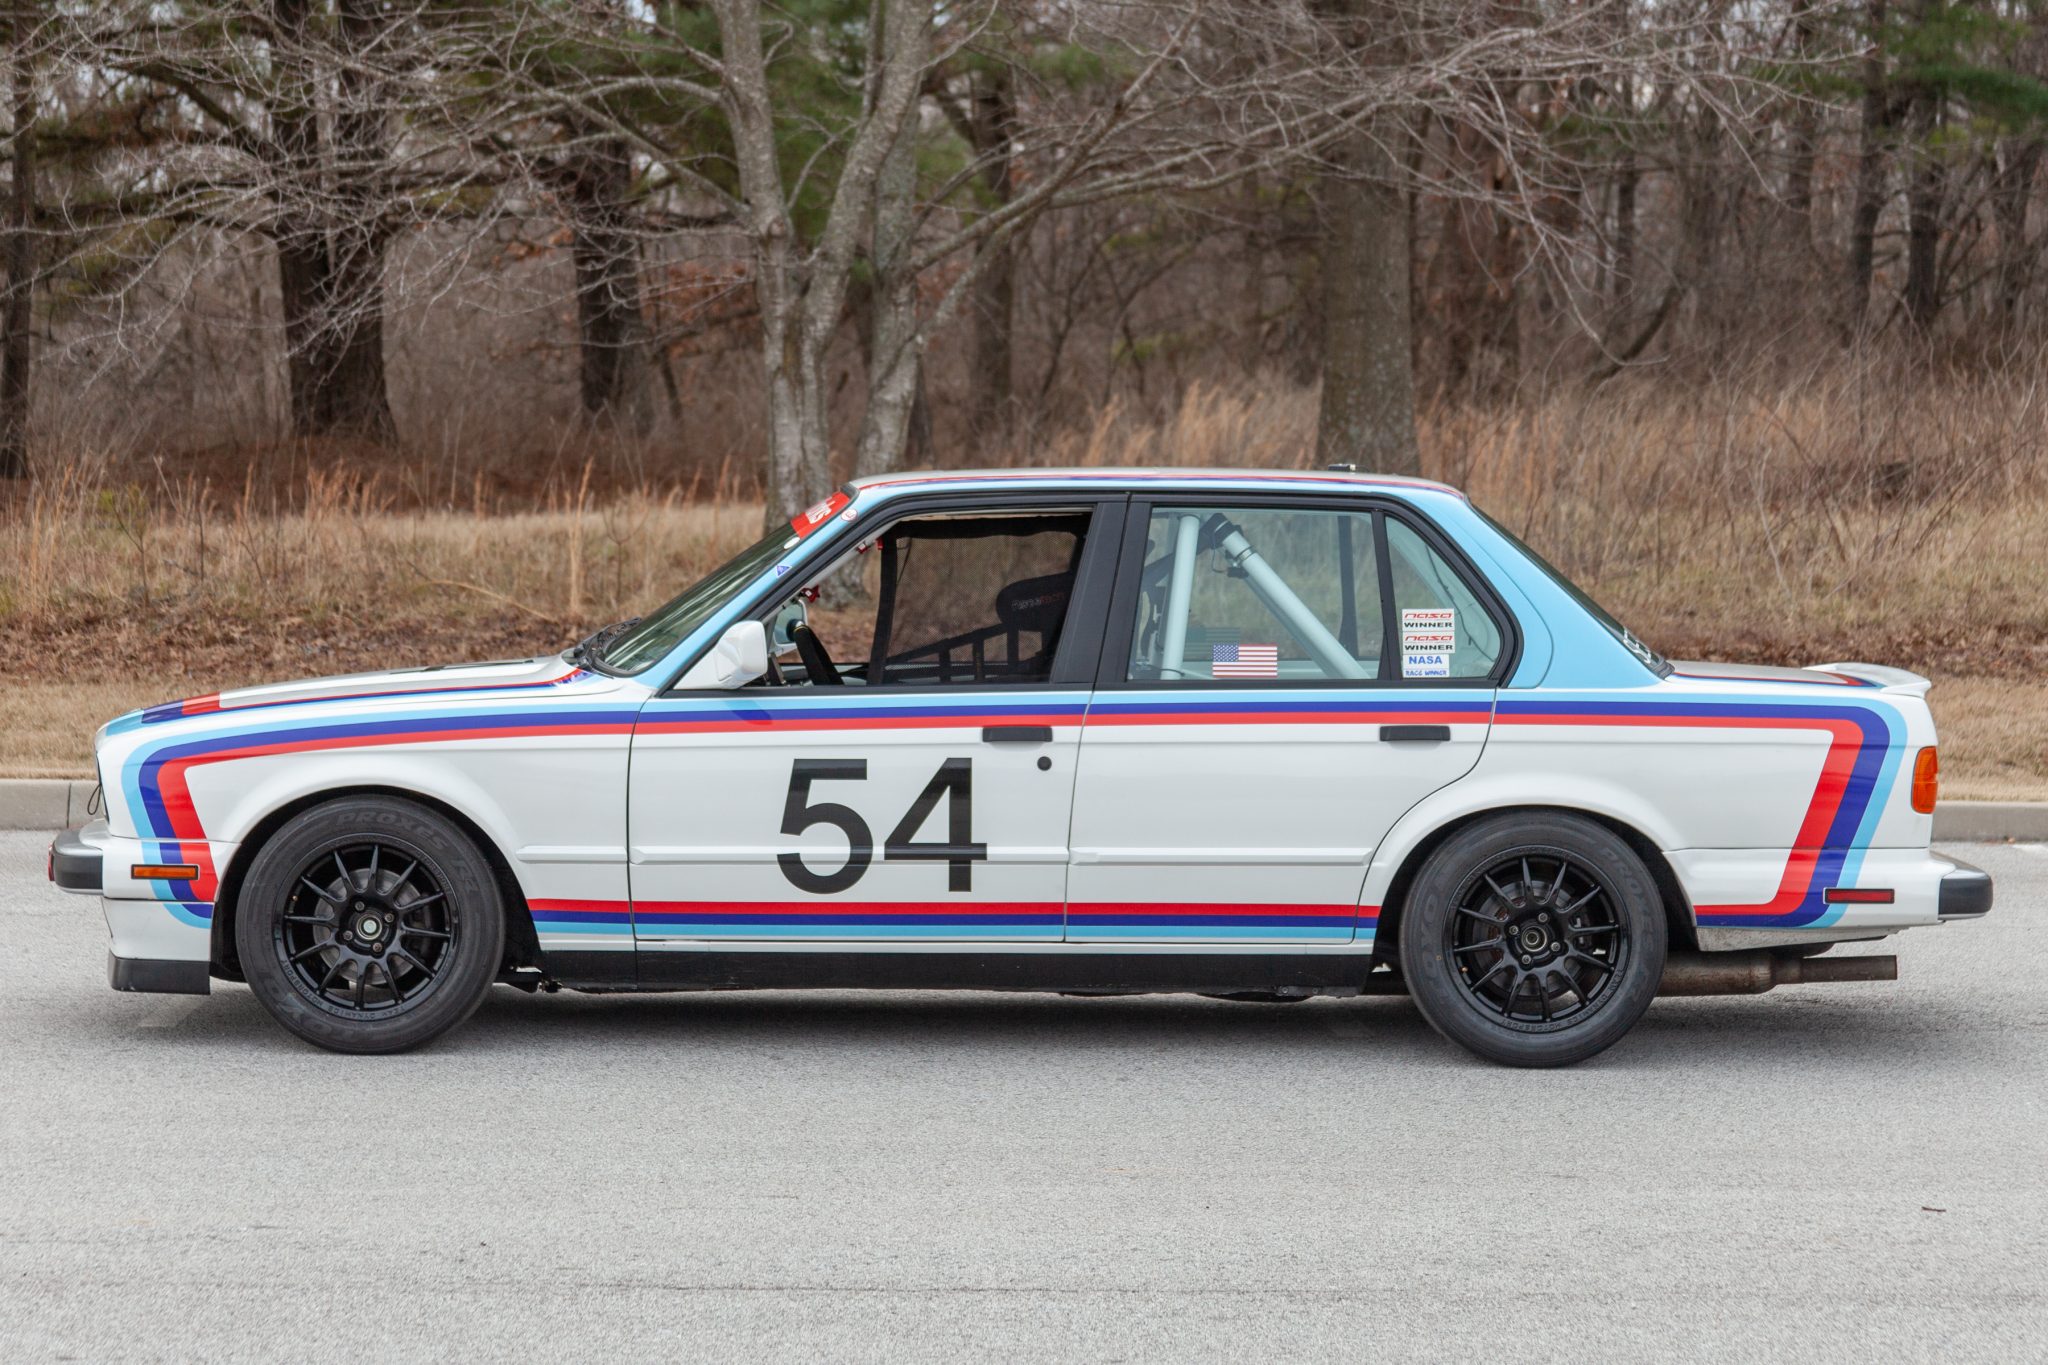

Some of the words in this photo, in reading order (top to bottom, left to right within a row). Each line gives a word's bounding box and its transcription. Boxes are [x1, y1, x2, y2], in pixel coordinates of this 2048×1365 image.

[1409, 656, 1442, 664] NASA
[336, 811, 447, 850] PROXES
[777, 757, 987, 894] 54
